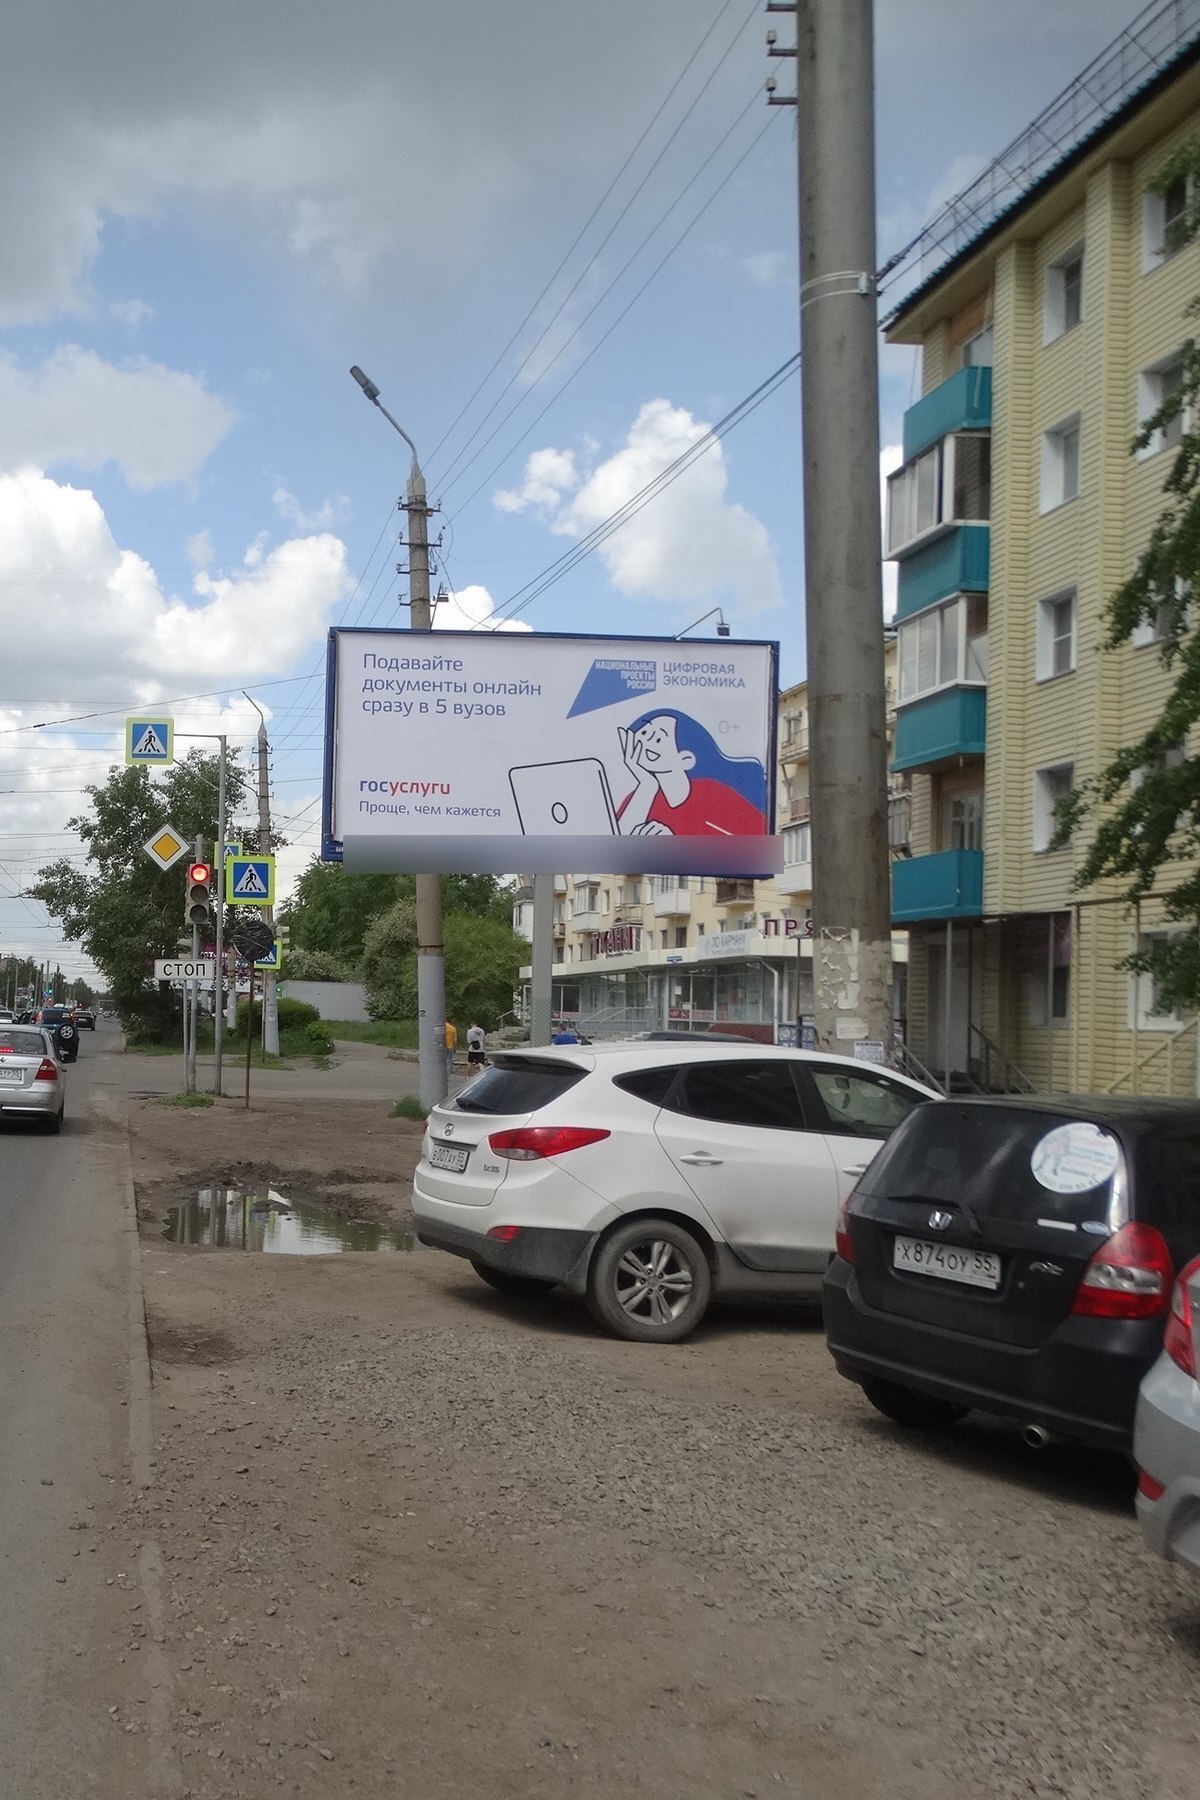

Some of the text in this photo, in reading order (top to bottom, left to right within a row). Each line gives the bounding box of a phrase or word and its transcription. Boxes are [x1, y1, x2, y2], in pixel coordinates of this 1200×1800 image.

[363, 653, 464, 672] Подавайте
[595, 661, 655, 671] НАЦИОНАЛЬНЫЕ
[663, 662, 735, 675] ЦИФРОВАЯ
[620, 670, 655, 681] ПРОЕКТЫ
[663, 675, 746, 689] ЭКОНОМИКА
[362, 678, 542, 696] документы онлайн
[626, 680, 655, 690] РОССИИ
[362, 699, 506, 720] сразу в 5 вузов
[359, 800, 501, 817] Проще, чем кажется
[163, 963, 206, 976] СТОП
[974, 1253, 992, 1271] 55
